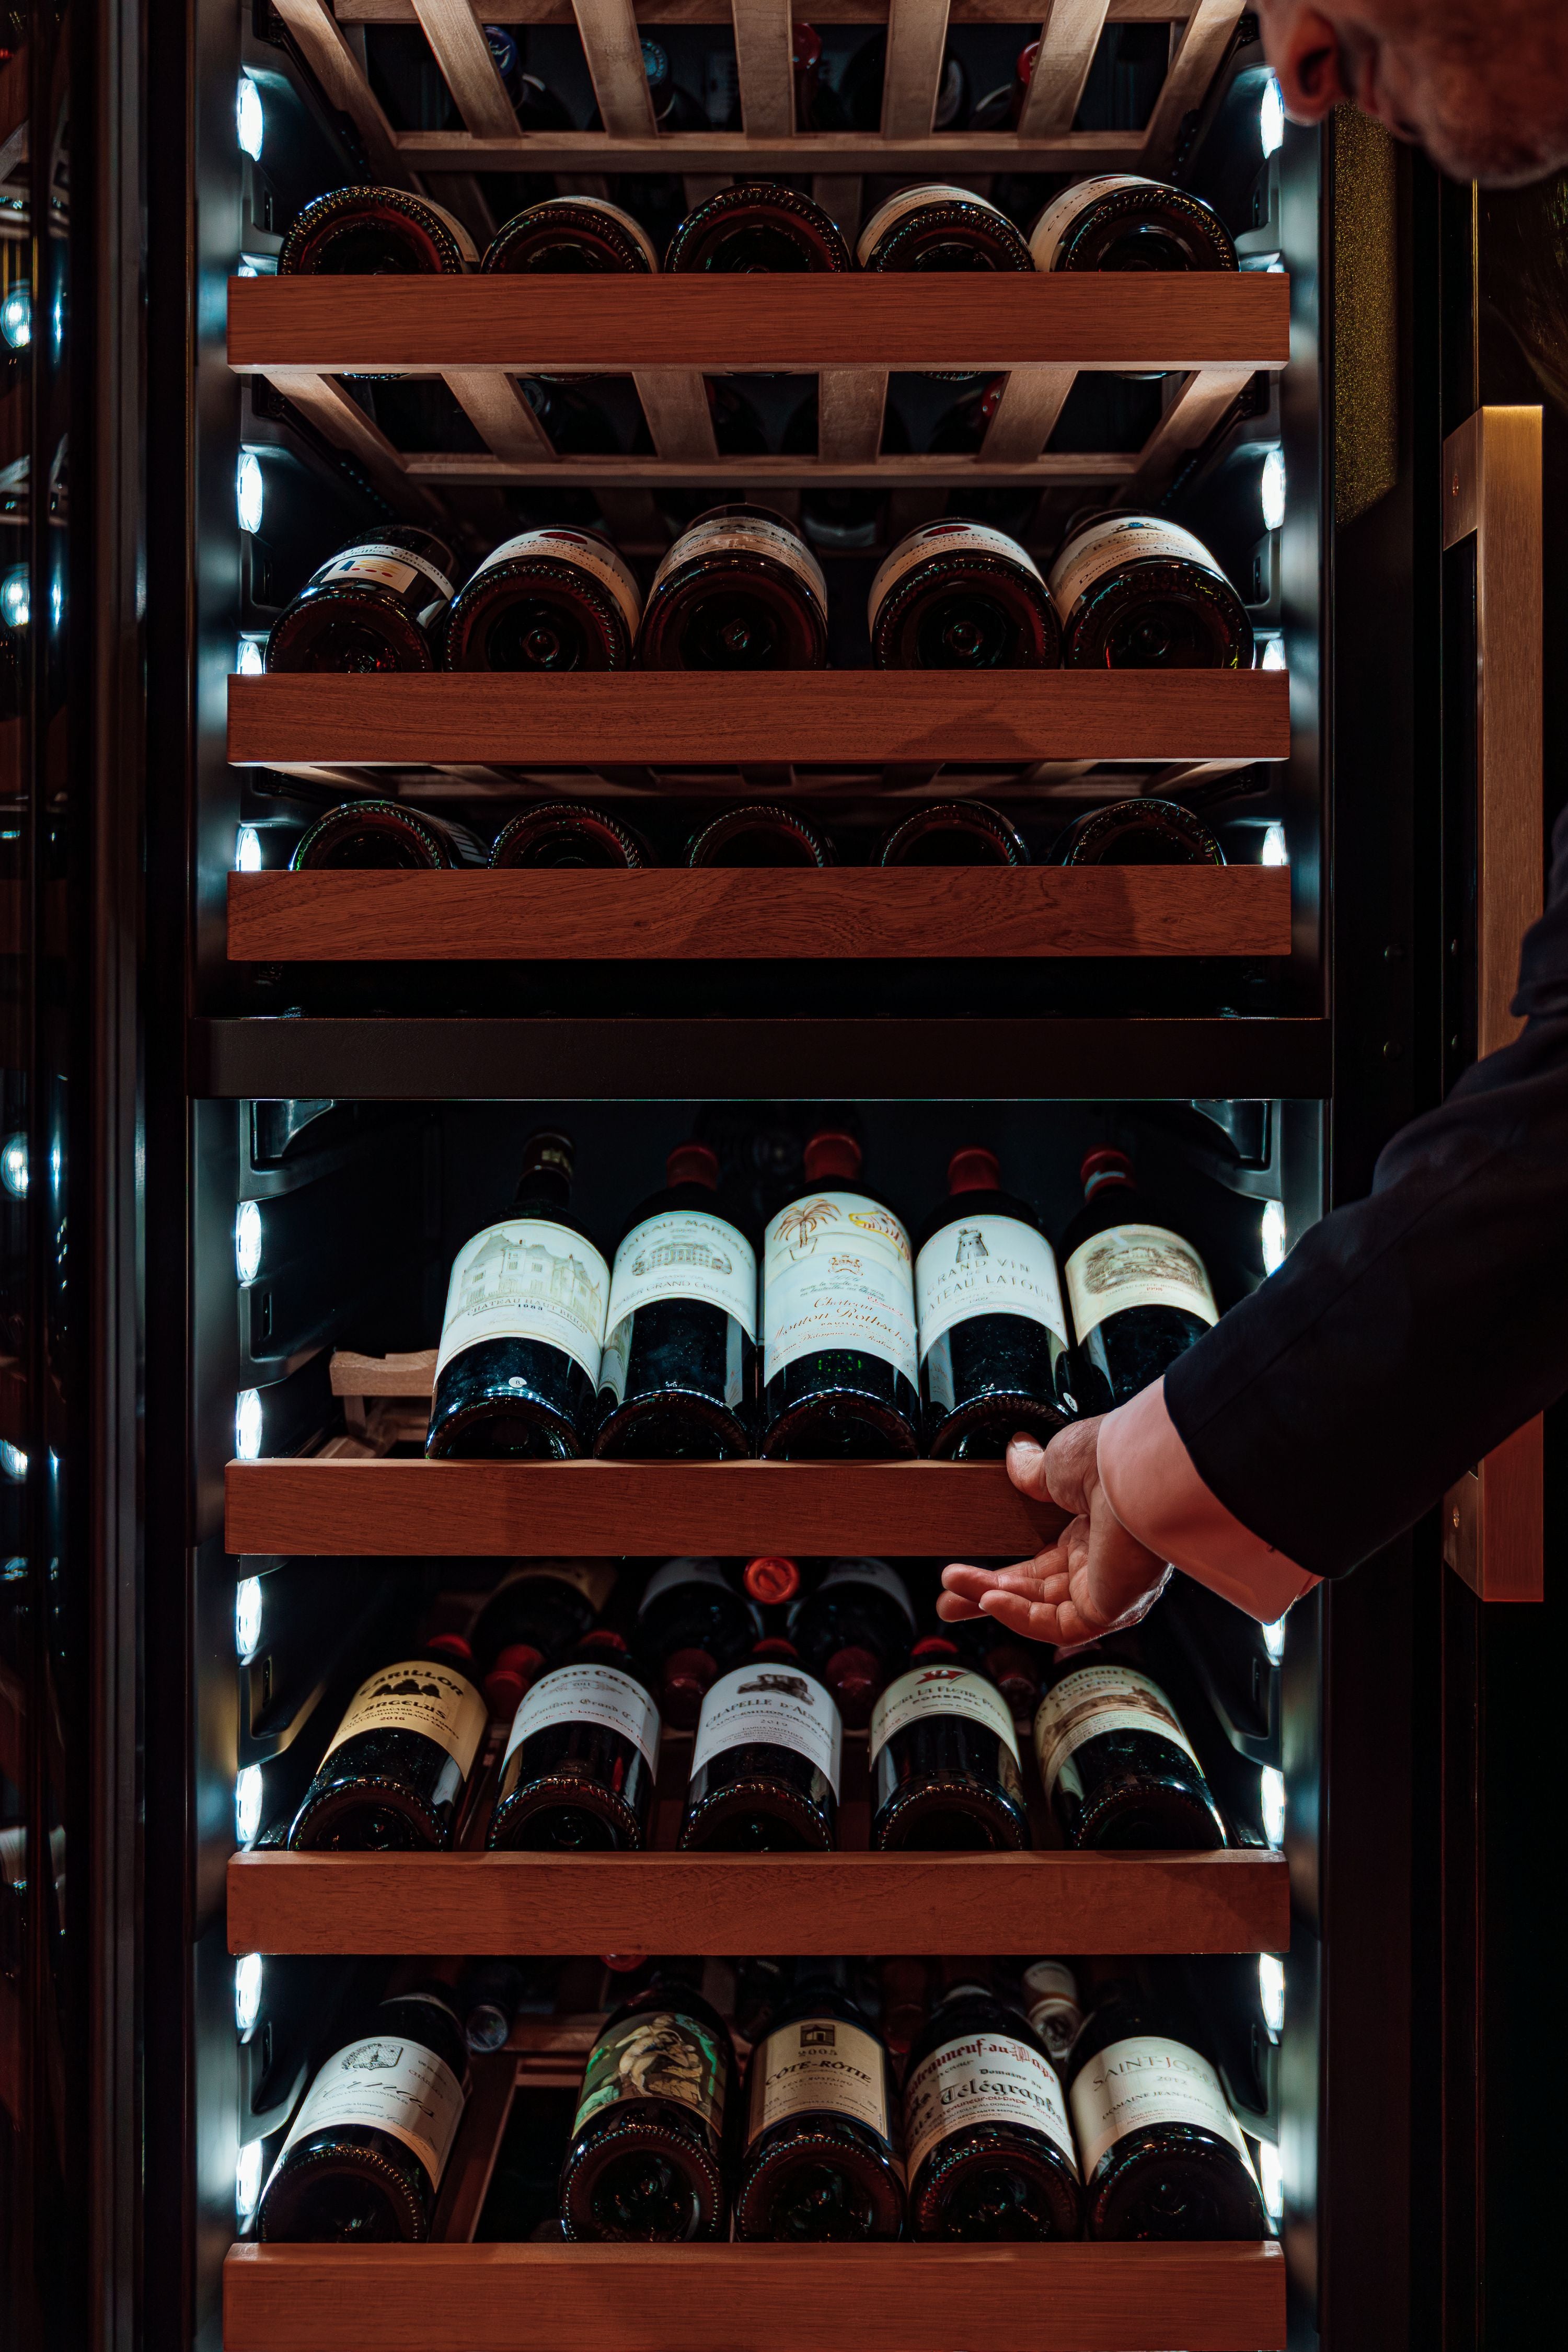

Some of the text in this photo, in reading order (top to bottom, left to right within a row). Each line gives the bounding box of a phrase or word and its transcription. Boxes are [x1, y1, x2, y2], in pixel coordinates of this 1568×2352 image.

[647, 1280, 690, 1292] GRAND
[927, 1260, 987, 1296] GRAND
[997, 1259, 1030, 1274] VIN
[985, 1274, 1055, 1305] LATOUR
[525, 1298, 556, 1310] HAUT
[560, 1308, 589, 1334] BRION
[773, 1313, 829, 1342] Mouton
[540, 1670, 590, 1689] PETIT
[706, 1699, 773, 1728] CHAPELLE
[912, 1694, 982, 1707] POMEROL
[760, 1719, 788, 1727] 2019
[765, 2060, 872, 2086] CÔTE-RÔTIE
[978, 2068, 1027, 2081] Domaine
[940, 2078, 1066, 2127] Télégraphe
[1102, 2092, 1149, 2120] DOMAINE
